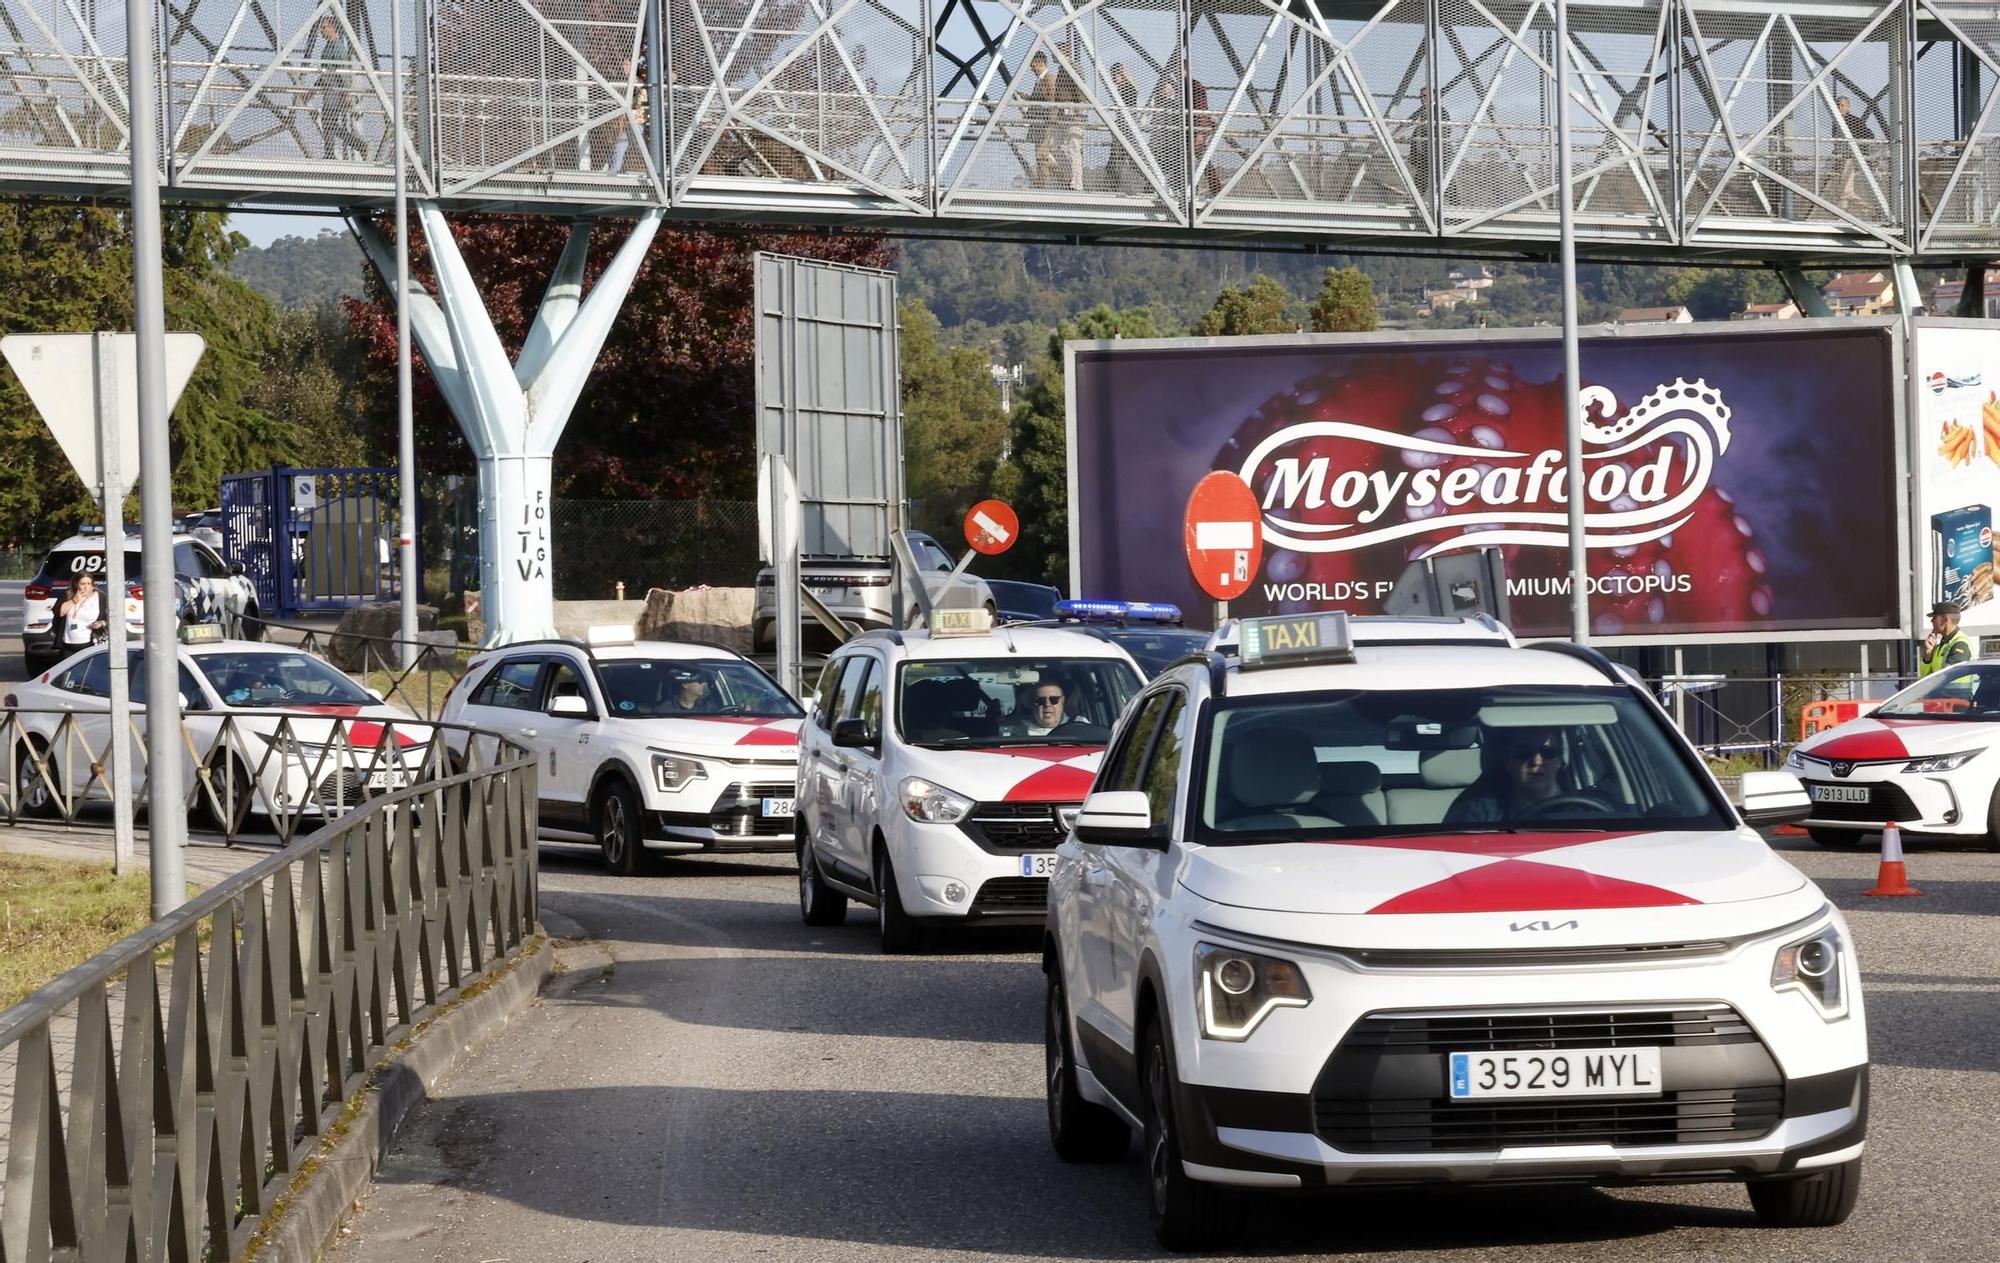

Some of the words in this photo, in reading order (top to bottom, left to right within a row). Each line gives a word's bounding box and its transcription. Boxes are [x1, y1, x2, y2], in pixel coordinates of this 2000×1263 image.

[1262, 445, 1674, 524] Moyseafood
[535, 490, 546, 579] FOLGA
[1263, 581, 1369, 602] WORLD'S
[1506, 577, 1571, 596] MIUM
[1262, 621, 1317, 650] TAXI
[772, 801, 796, 814] 284
[1817, 788, 1843, 801] 7913
[1036, 857, 1056, 873] 35
[1478, 1056, 1570, 1090] 3529
[1585, 1054, 1652, 1088] MYL
